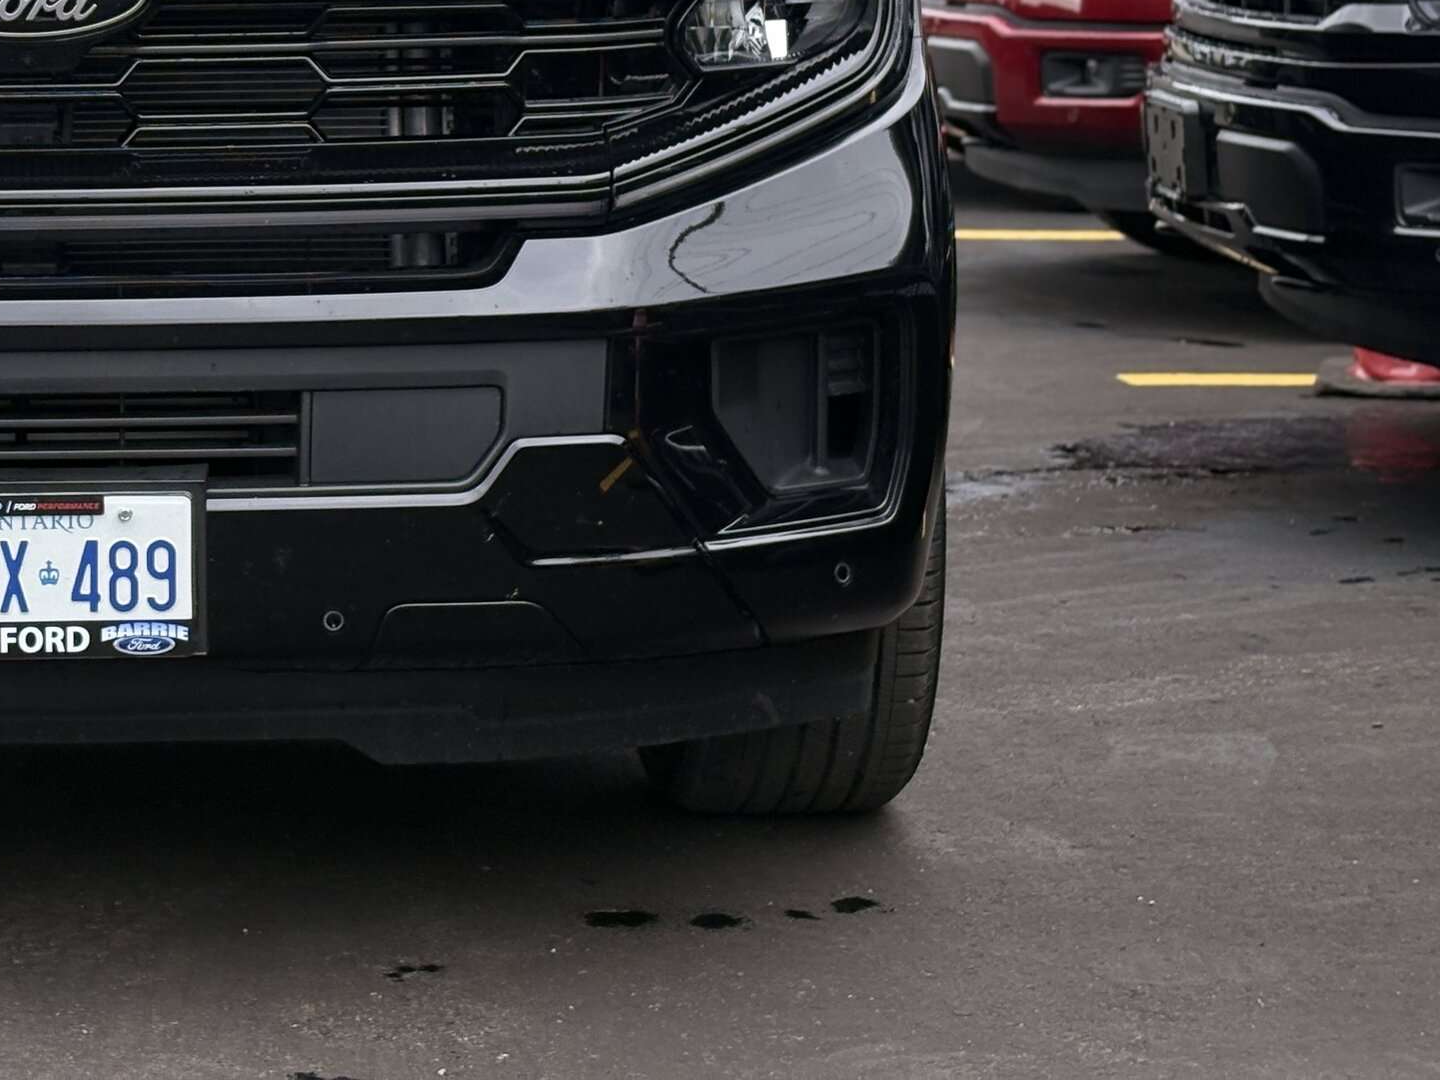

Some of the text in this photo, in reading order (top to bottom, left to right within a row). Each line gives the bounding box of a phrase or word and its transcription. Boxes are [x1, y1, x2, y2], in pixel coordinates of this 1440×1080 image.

[13, 503, 37, 511] FORD
[37, 502, 100, 510] PERFORMANCE
[71, 539, 177, 613] 489
[0, 626, 90, 654] FORD
[101, 622, 189, 642] BARRIE
[127, 638, 162, 651] Ford
